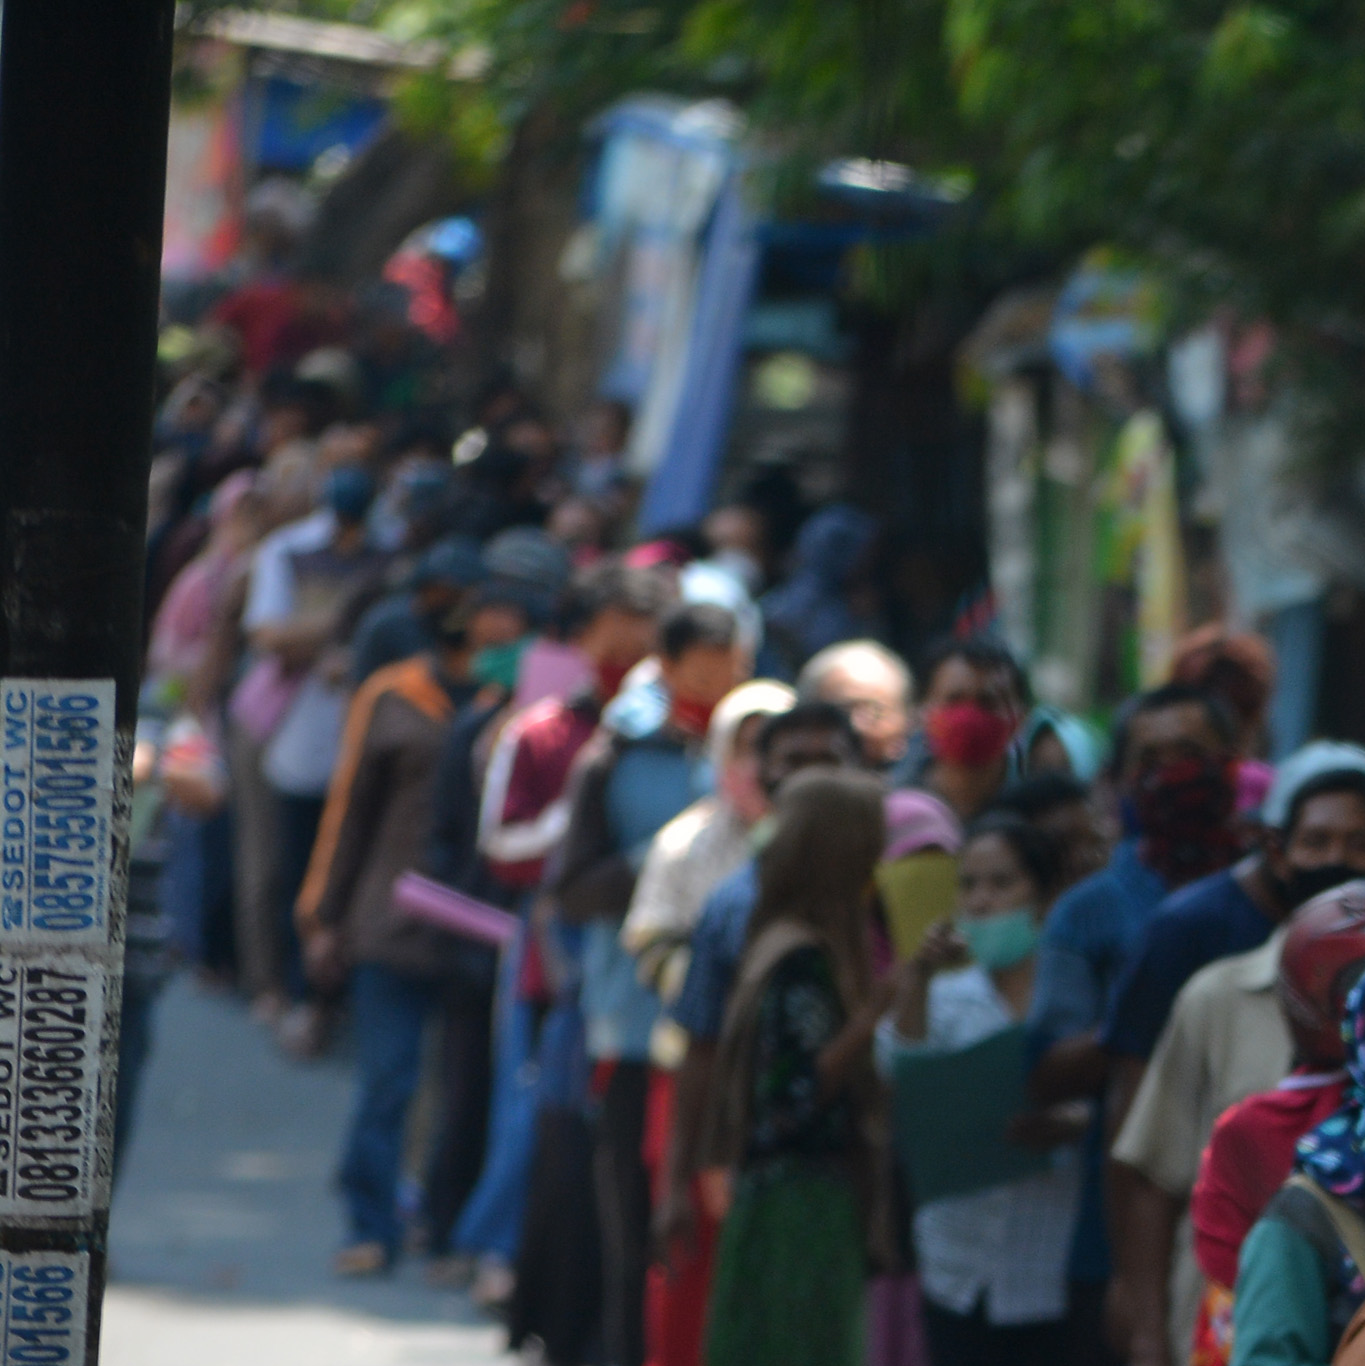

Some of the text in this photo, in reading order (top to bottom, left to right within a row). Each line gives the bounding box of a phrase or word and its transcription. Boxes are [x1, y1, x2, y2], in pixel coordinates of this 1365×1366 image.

[3, 690, 28, 891] SEDOT WC
[32, 694, 100, 931] 085755001566
[17, 967, 88, 1201] 081333660287
